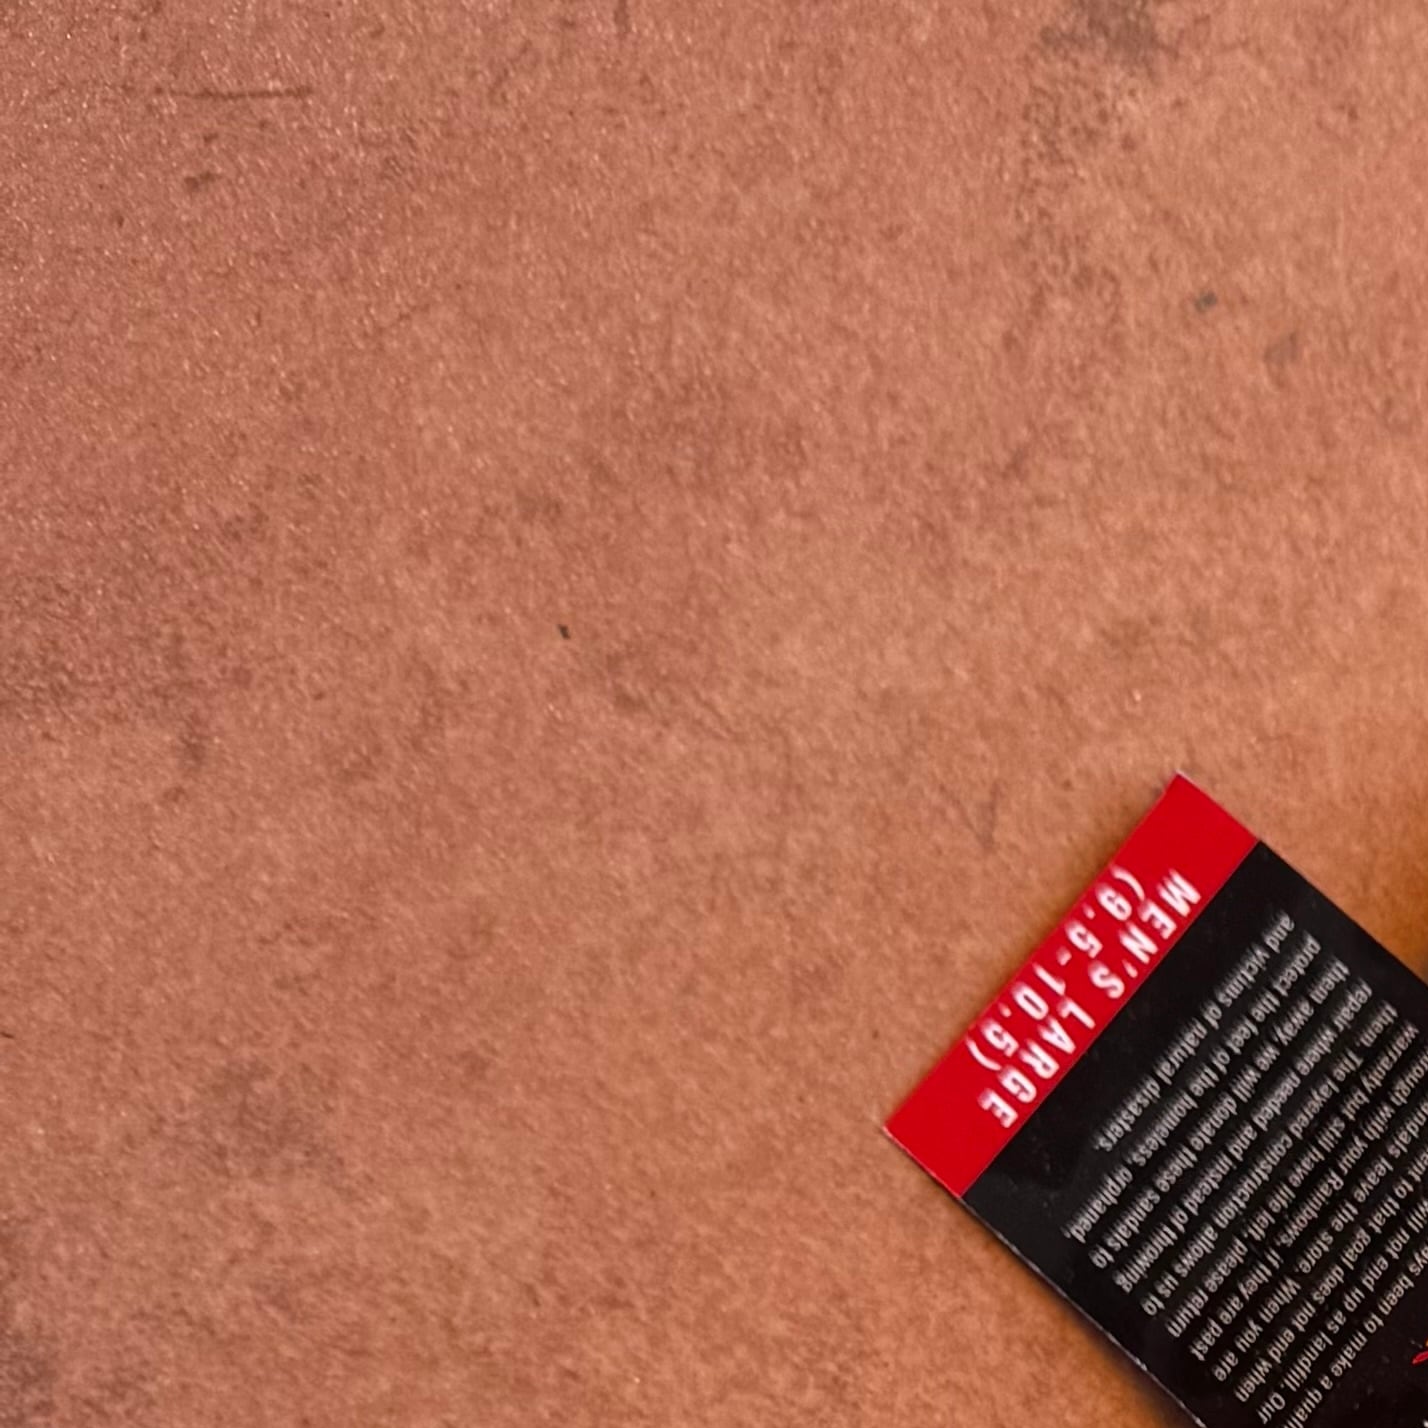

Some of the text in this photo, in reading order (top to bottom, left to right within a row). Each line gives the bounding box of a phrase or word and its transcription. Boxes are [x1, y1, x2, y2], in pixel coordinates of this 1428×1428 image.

[1262, 912, 1295, 954] and
[1215, 945, 1270, 1007] victims
[1271, 932, 1321, 997] protect
[1308, 957, 1350, 1004] them
[980, 871, 1200, 1127] MEN'S LARGE
[1201, 1000, 1222, 1030] of
[1249, 989, 1281, 1022] the
[1154, 1018, 1208, 1085] natural
[1223, 1015, 1259, 1055] feet
[1208, 1045, 1231, 1075] of
[1254, 1041, 1280, 1071] we
[1331, 1047, 1364, 1082] The
[1359, 1021, 1419, 1094] warranty
[1187, 1062, 1219, 1097] the
[1229, 1064, 1262, 1103] will
[1188, 1092, 1238, 1151] donate
[1287, 1075, 1340, 1140] layered
[1340, 1087, 1370, 1121] but
[1359, 1102, 1395, 1141] with
[1113, 978, 1372, 1293] repair where needed and instead of throwing
[1315, 1115, 1346, 1153] still
[1154, 1144, 1198, 1192] these
[1287, 1144, 1325, 1188] have
[1336, 1134, 1369, 1176] your
[1211, 1131, 1293, 1228] construction
[1267, 1181, 1296, 1213] life
[1352, 1154, 1394, 1203] leave
[1392, 1176, 1414, 1199] to
[1104, 1188, 1161, 1251] sandals
[1329, 1199, 1359, 1232] the
[1366, 1194, 1400, 1234] that
[1089, 1244, 1115, 1269] to
[1173, 1223, 1218, 1277] allows
[1263, 1246, 1284, 1270] if
[1339, 1226, 1371, 1270] goal
[1384, 1226, 1411, 1260] not
[1202, 1235, 1248, 1293] please
[1236, 1260, 1273, 1301] they
[1360, 1254, 1389, 1292] end
[1154, 1271, 1179, 1298] us
[1257, 1276, 1301, 1323] When
[1310, 1263, 1345, 1305] does
[1342, 1285, 1366, 1312] up
[1377, 1272, 1415, 1315] been
[1140, 1292, 1165, 1316] to
[1165, 1286, 1209, 1338] return
[1218, 1294, 1244, 1325] are
[1290, 1299, 1316, 1332] not
[1325, 1308, 1347, 1334] as
[1362, 1311, 1384, 1334] to
[1189, 1317, 1223, 1361] past
[1234, 1318, 1263, 1353] you
[1266, 1326, 1295, 1364] end
[1329, 1330, 1368, 1377] make
[1212, 1350, 1239, 1382] are
[1234, 1357, 1273, 1402] when
[1318, 1374, 1334, 1390] a
[1256, 1391, 1286, 1425] Our
